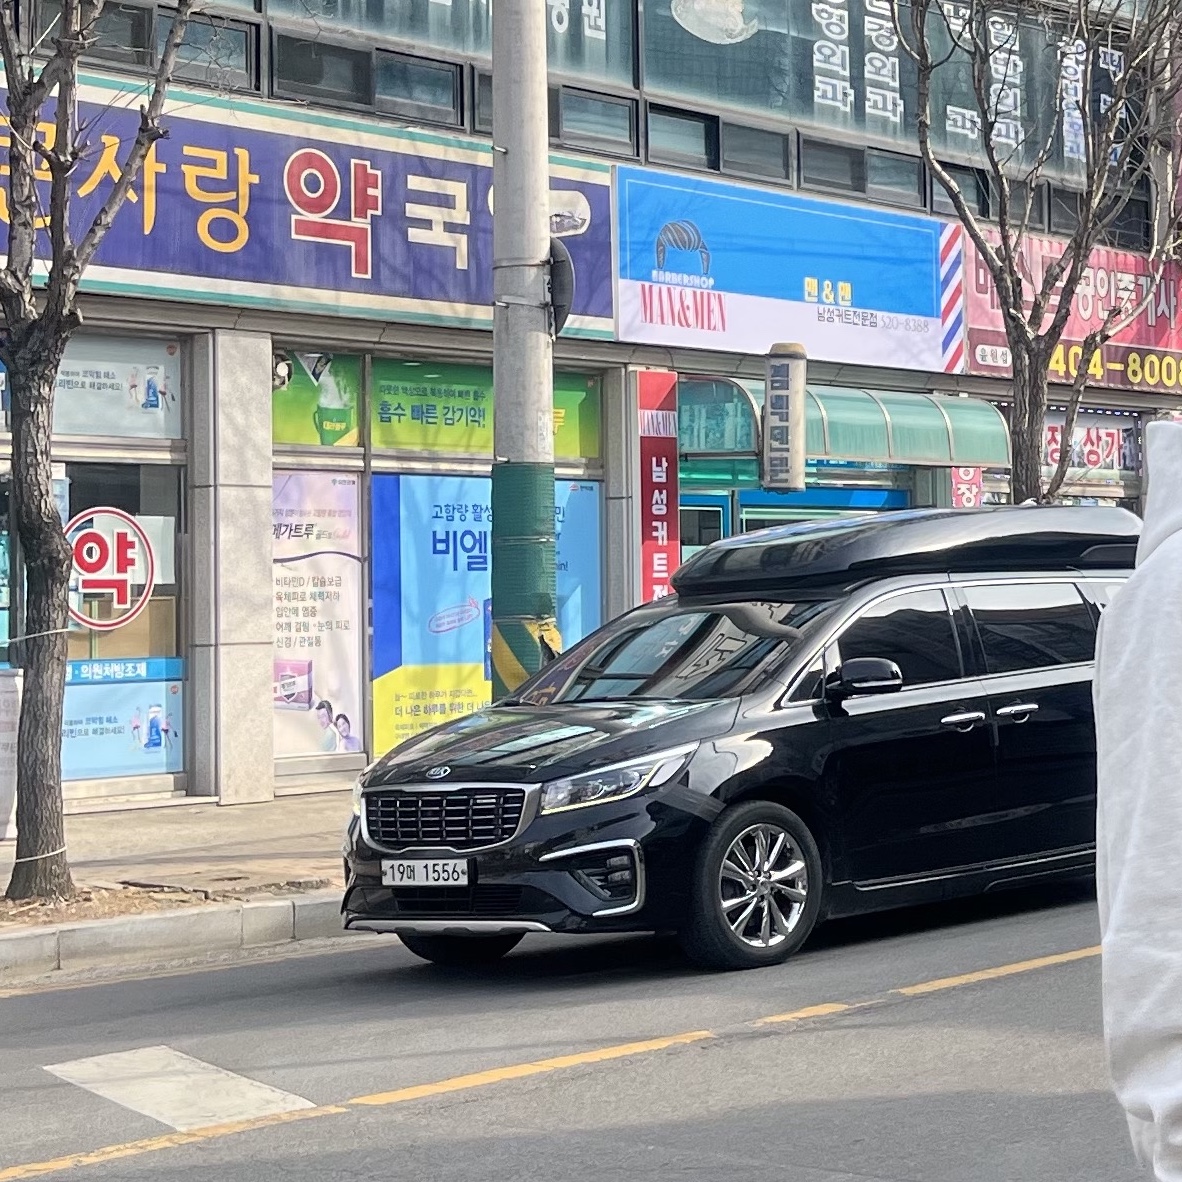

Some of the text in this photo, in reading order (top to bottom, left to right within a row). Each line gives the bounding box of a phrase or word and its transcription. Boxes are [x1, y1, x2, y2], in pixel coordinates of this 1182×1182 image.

[812, 0, 854, 112] 형외과
[283, 148, 470, 279] 약국
[651, 270, 715, 289] BARBERSHOP
[640, 284, 727, 333] MAN&MEN
[55, 378, 87, 390] 리빈으로
[378, 401, 486, 428] 흡수 빠른 감기약!
[432, 504, 468, 522] 고함량
[73, 528, 138, 608] 약
[80, 662, 148, 680] 의원처방조제
[423, 862, 460, 882] 1556
